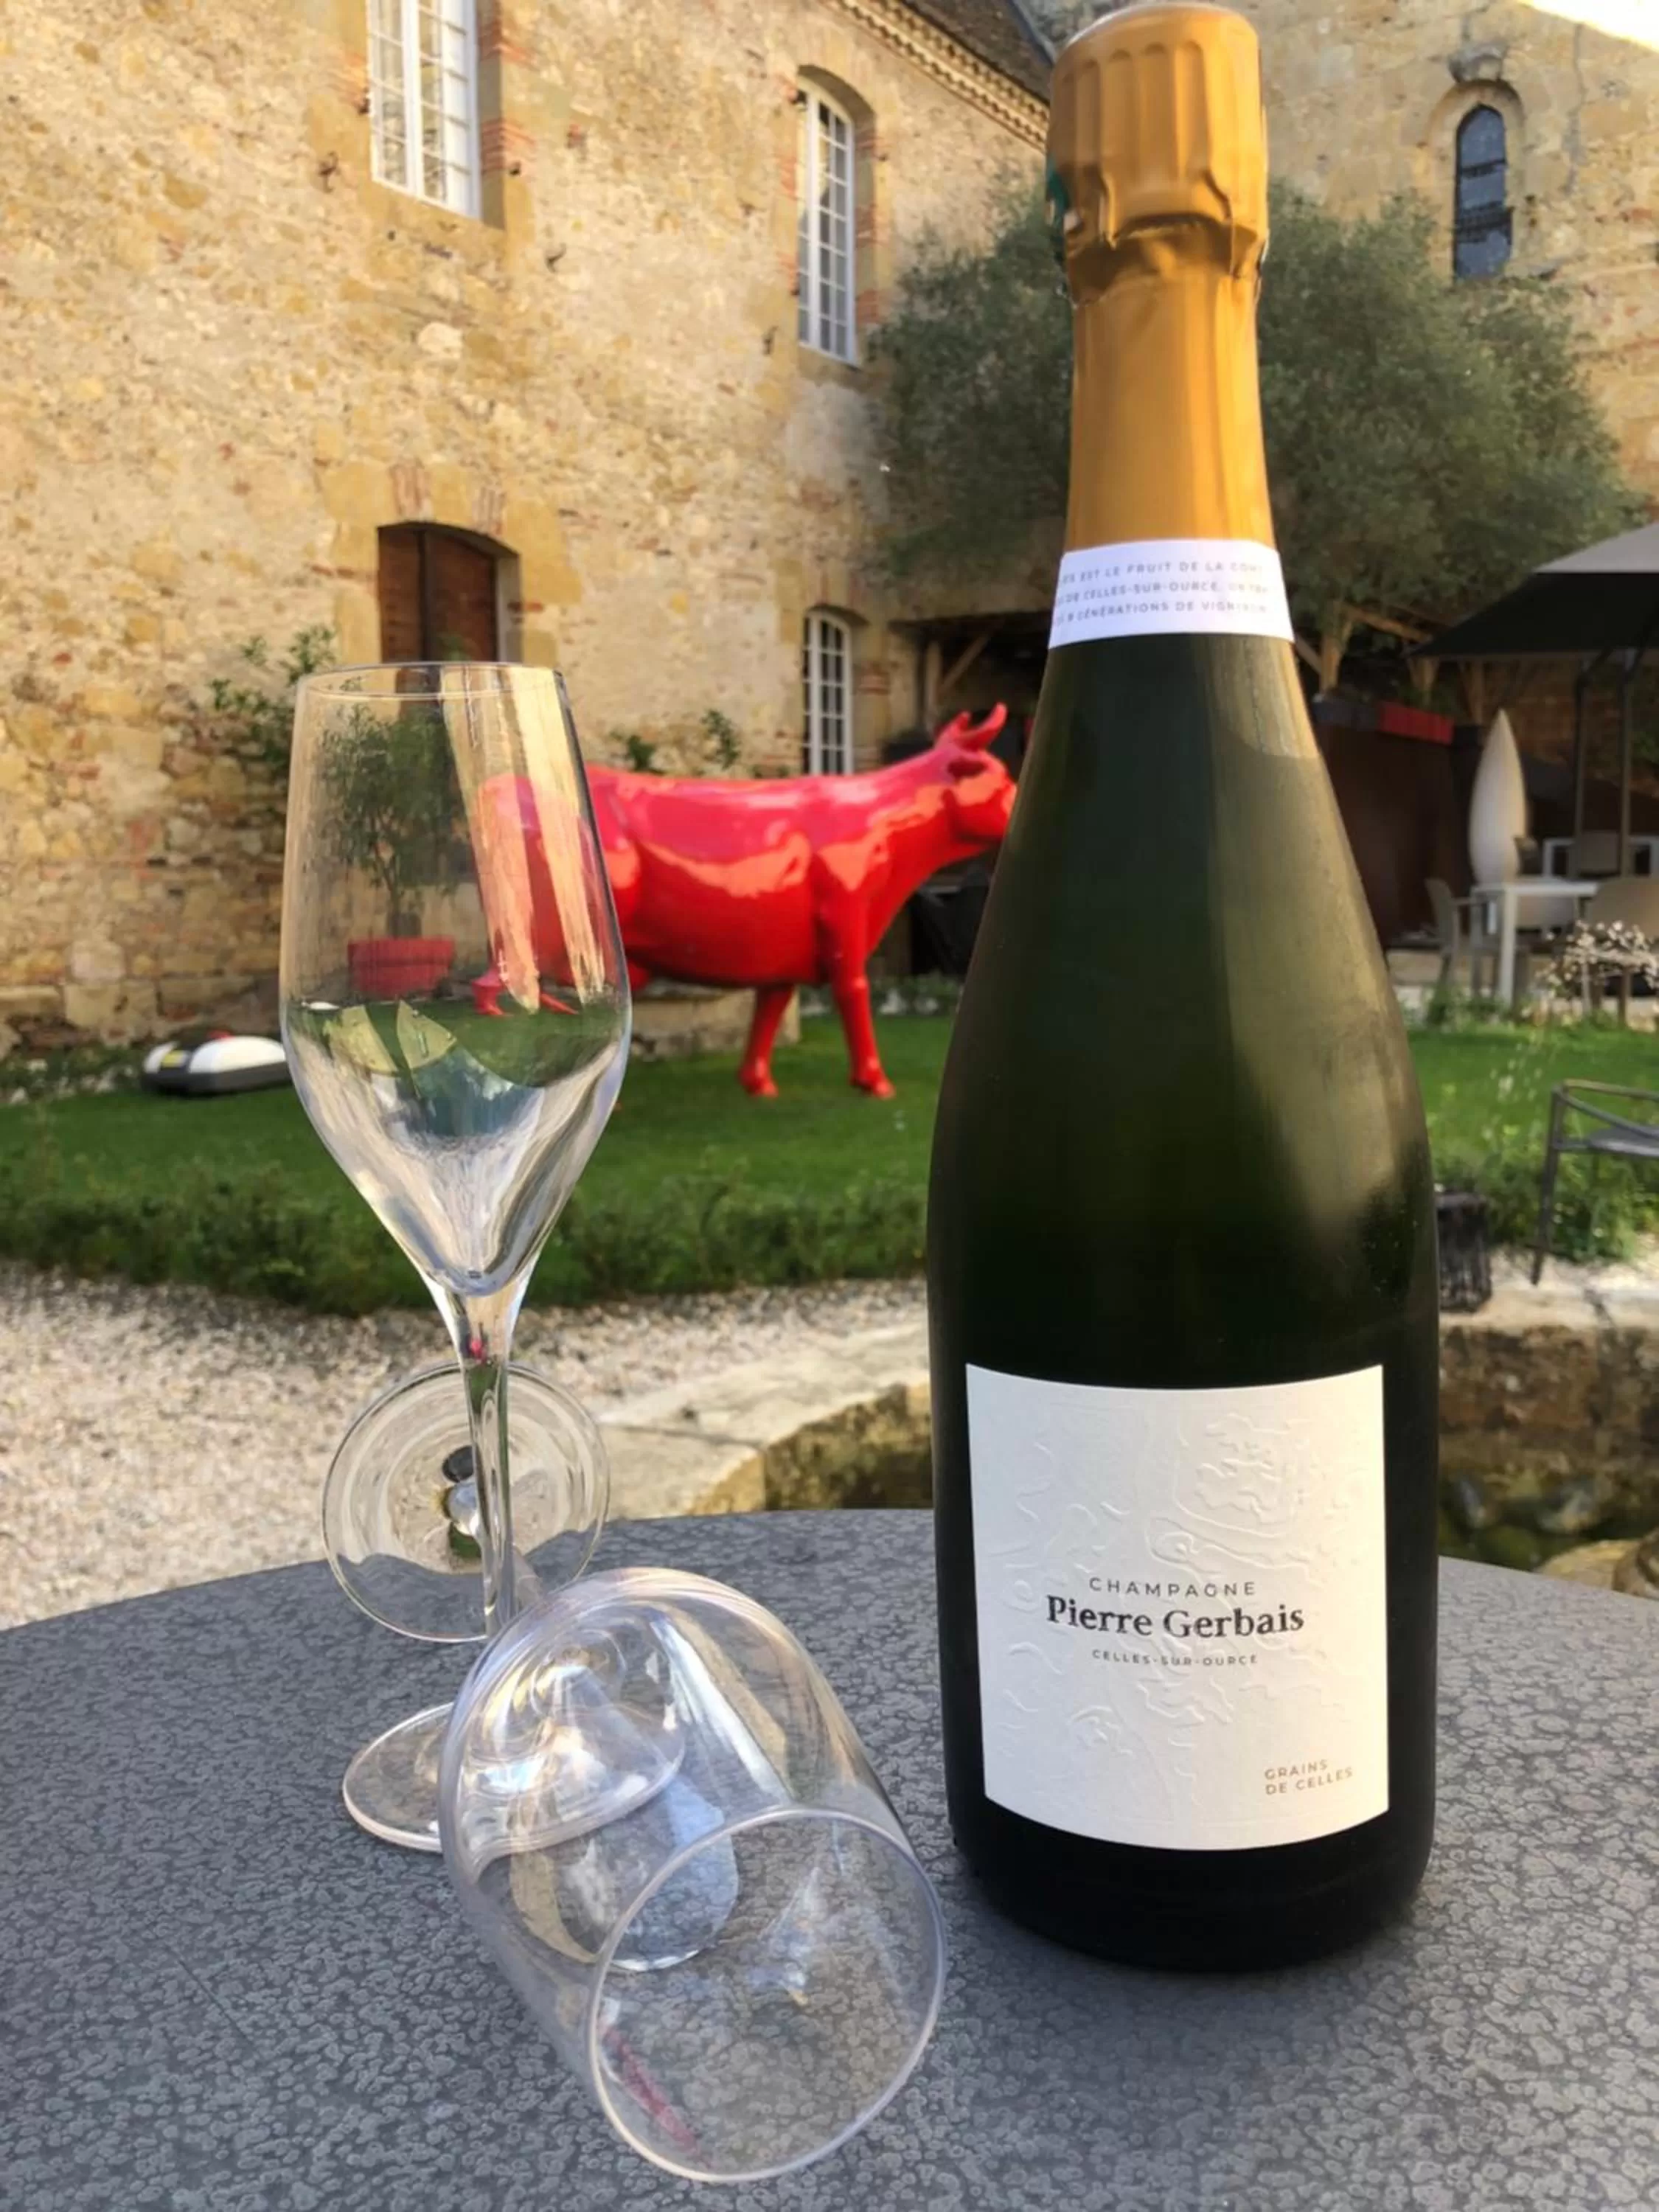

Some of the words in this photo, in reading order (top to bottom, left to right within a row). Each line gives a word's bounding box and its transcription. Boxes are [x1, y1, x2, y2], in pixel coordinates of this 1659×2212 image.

[1105, 566, 1121, 577] LE
[1126, 560, 1172, 574] FRUIT
[1179, 560, 1199, 572] DE
[1205, 561, 1224, 572] LA
[1175, 600, 1194, 611] DE
[1089, 1576, 1256, 1598] CHAMPAGNE
[1046, 1594, 1153, 1637] Pierre
[1163, 1604, 1305, 1638] Gerbais
[1092, 1649, 1258, 1667] CELLES-SUR-OURCE
[1264, 1759, 1329, 1781] GRAINS
[1265, 1782, 1287, 1795] DE
[1295, 1766, 1354, 1791] CELLES
